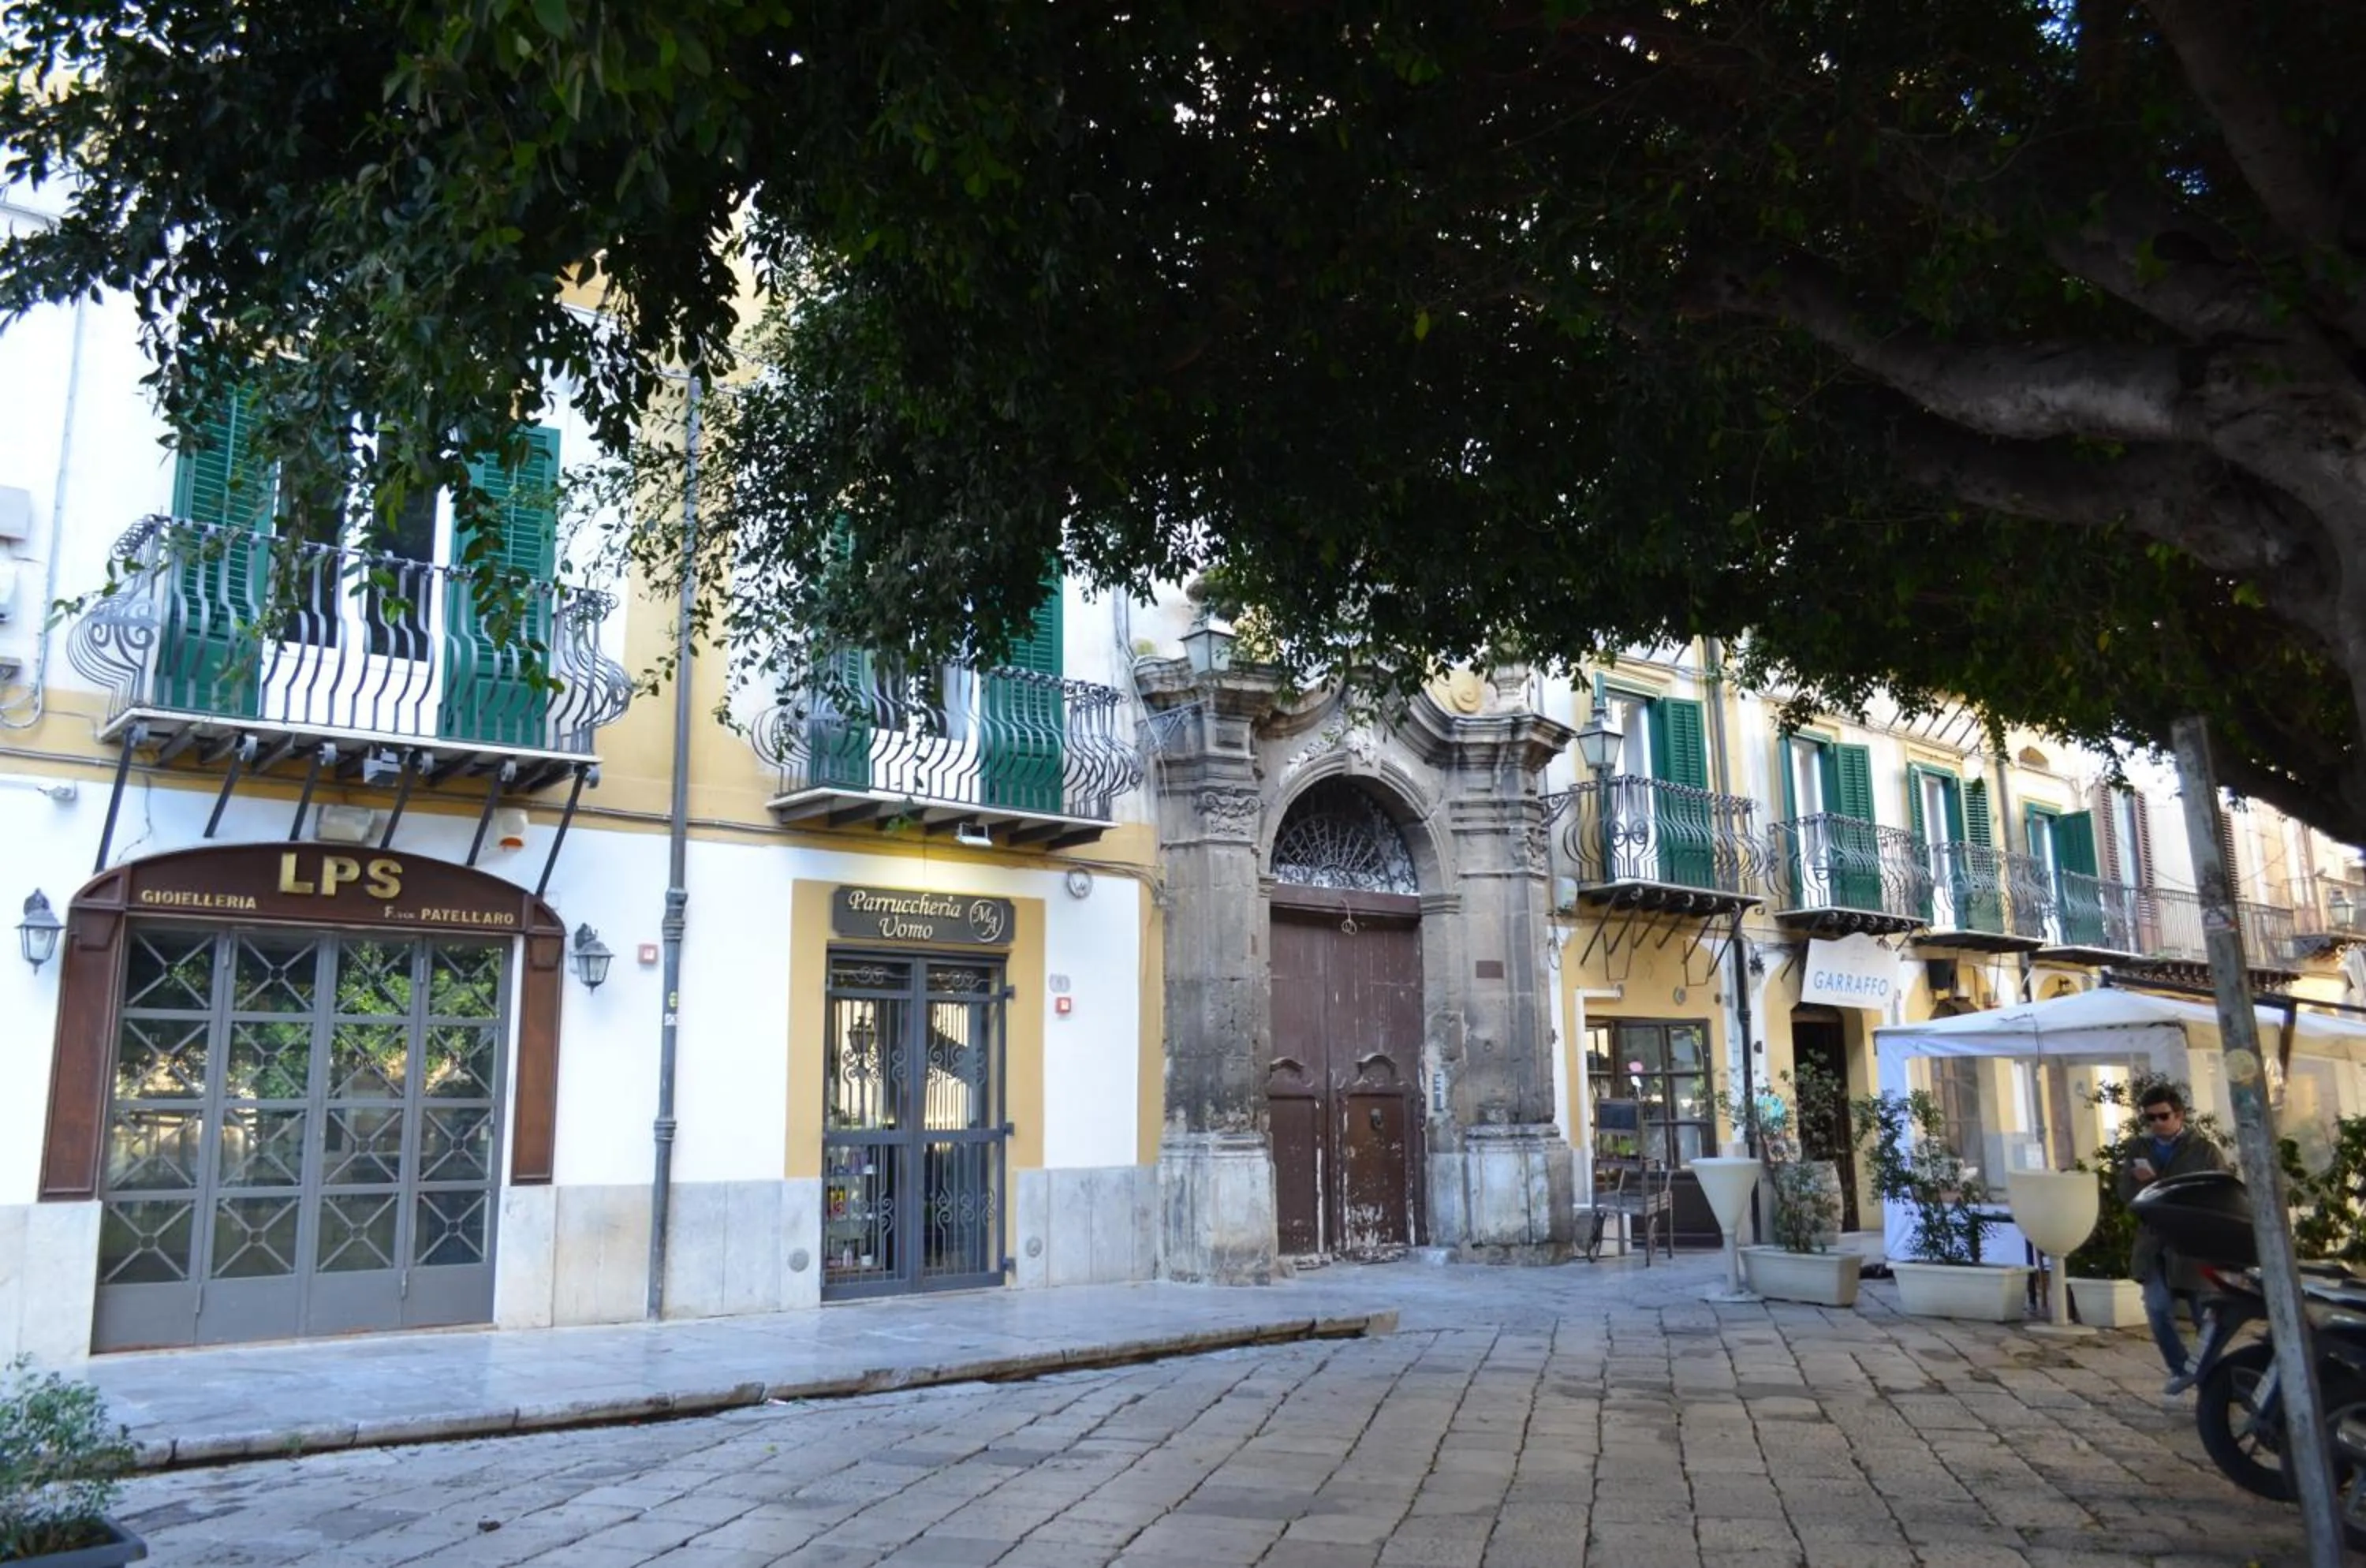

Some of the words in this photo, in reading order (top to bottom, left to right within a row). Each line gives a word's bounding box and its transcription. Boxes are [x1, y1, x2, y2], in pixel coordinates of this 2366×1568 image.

[278, 852, 404, 899] LPS
[140, 889, 257, 909] GIOIELLERIA
[848, 889, 961, 918] Parruccheria
[420, 908, 515, 925] PATELLARO
[879, 916, 934, 939] Uomo
[1814, 970, 1889, 997] GARRAFFO
